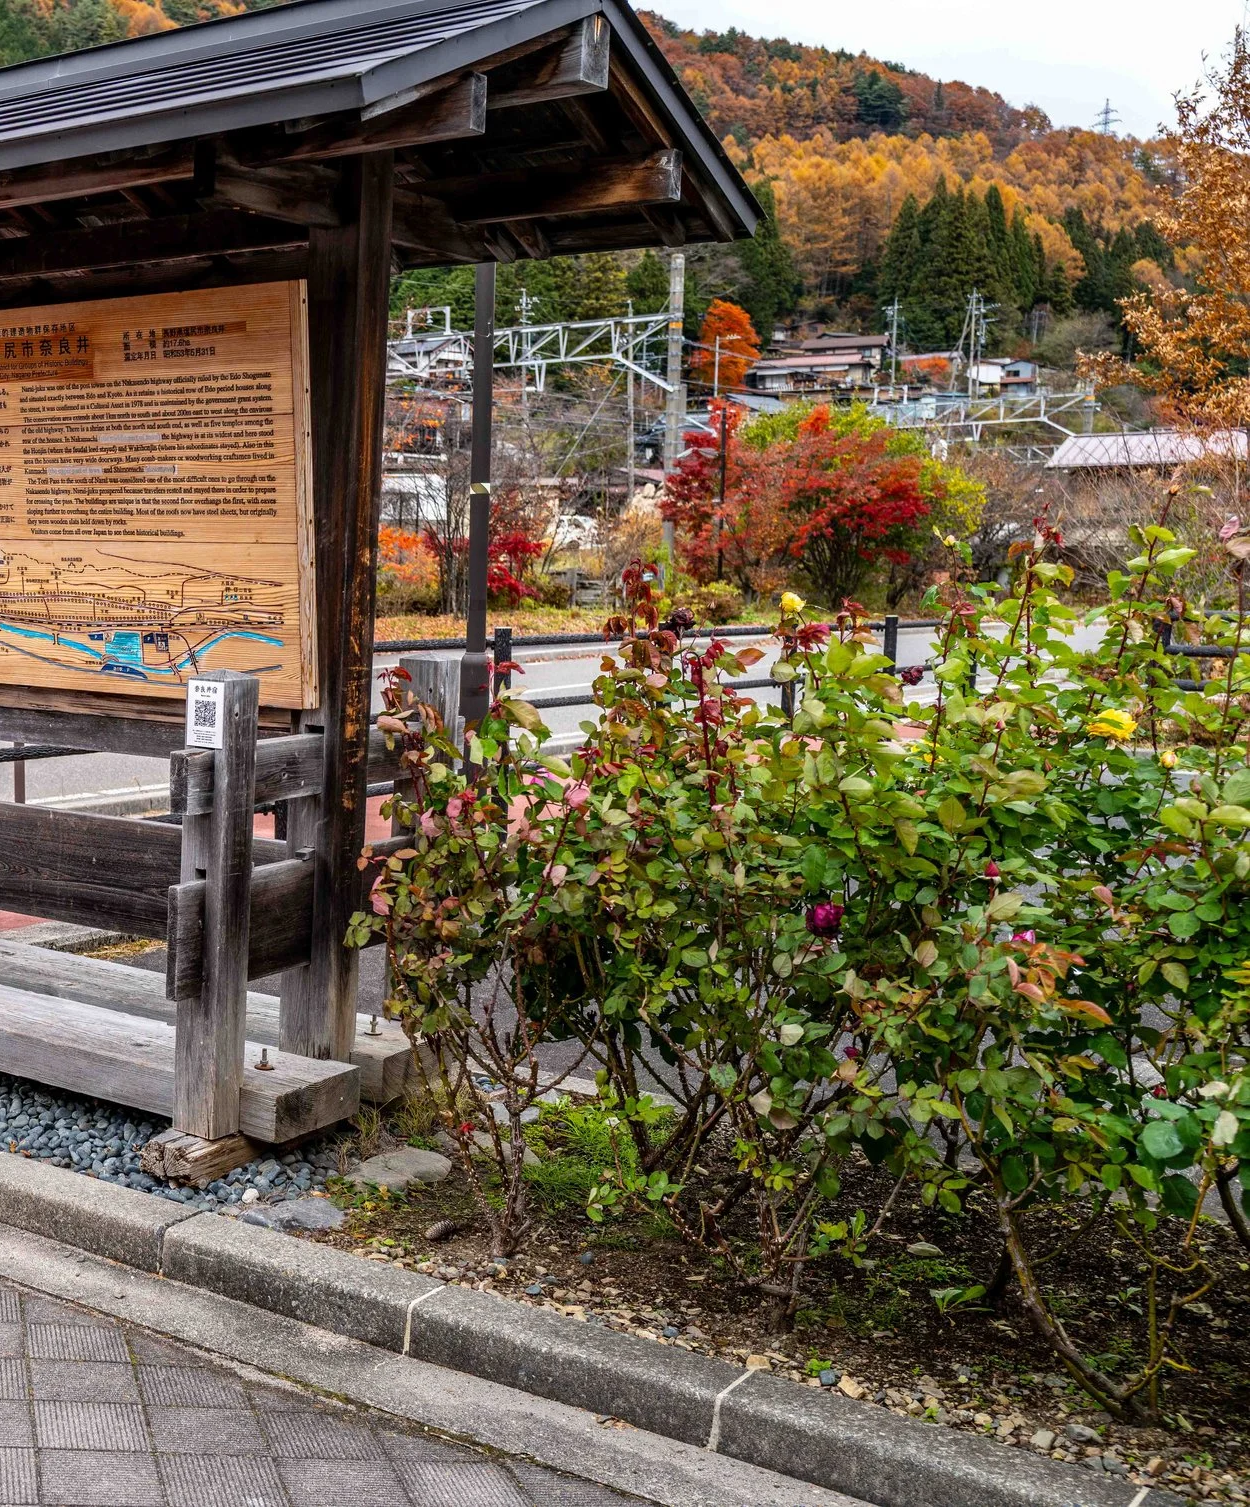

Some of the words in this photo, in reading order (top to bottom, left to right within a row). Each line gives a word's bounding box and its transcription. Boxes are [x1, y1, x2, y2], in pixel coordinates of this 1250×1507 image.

[150, 378, 172, 386] highway
[173, 376, 196, 385] officially
[242, 372, 271, 381] Shogunate
[107, 391, 124, 399] Kyoto.
[217, 385, 235, 394] period
[236, 384, 254, 392] houses
[255, 383, 271, 392] along
[205, 397, 236, 405] government
[237, 396, 251, 404] grant
[252, 395, 273, 403] system.
[224, 408, 239, 416] along
[248, 406, 272, 414] environs
[44, 426, 64, 434] highway.
[222, 419, 243, 428] temples
[171, 432, 193, 441] highway
[98, 456, 124, 464] doorways.
[125, 456, 140, 464] Many
[185, 454, 222, 462] woodworking
[193, 487, 210, 495] stayed
[194, 498, 221, 506] overhangs
[67, 508, 89, 516] overhang
[113, 508, 135, 516] building.
[249, 509, 277, 517] originally
[93, 529, 107, 537] Japan
[160, 530, 185, 538] buildings.
